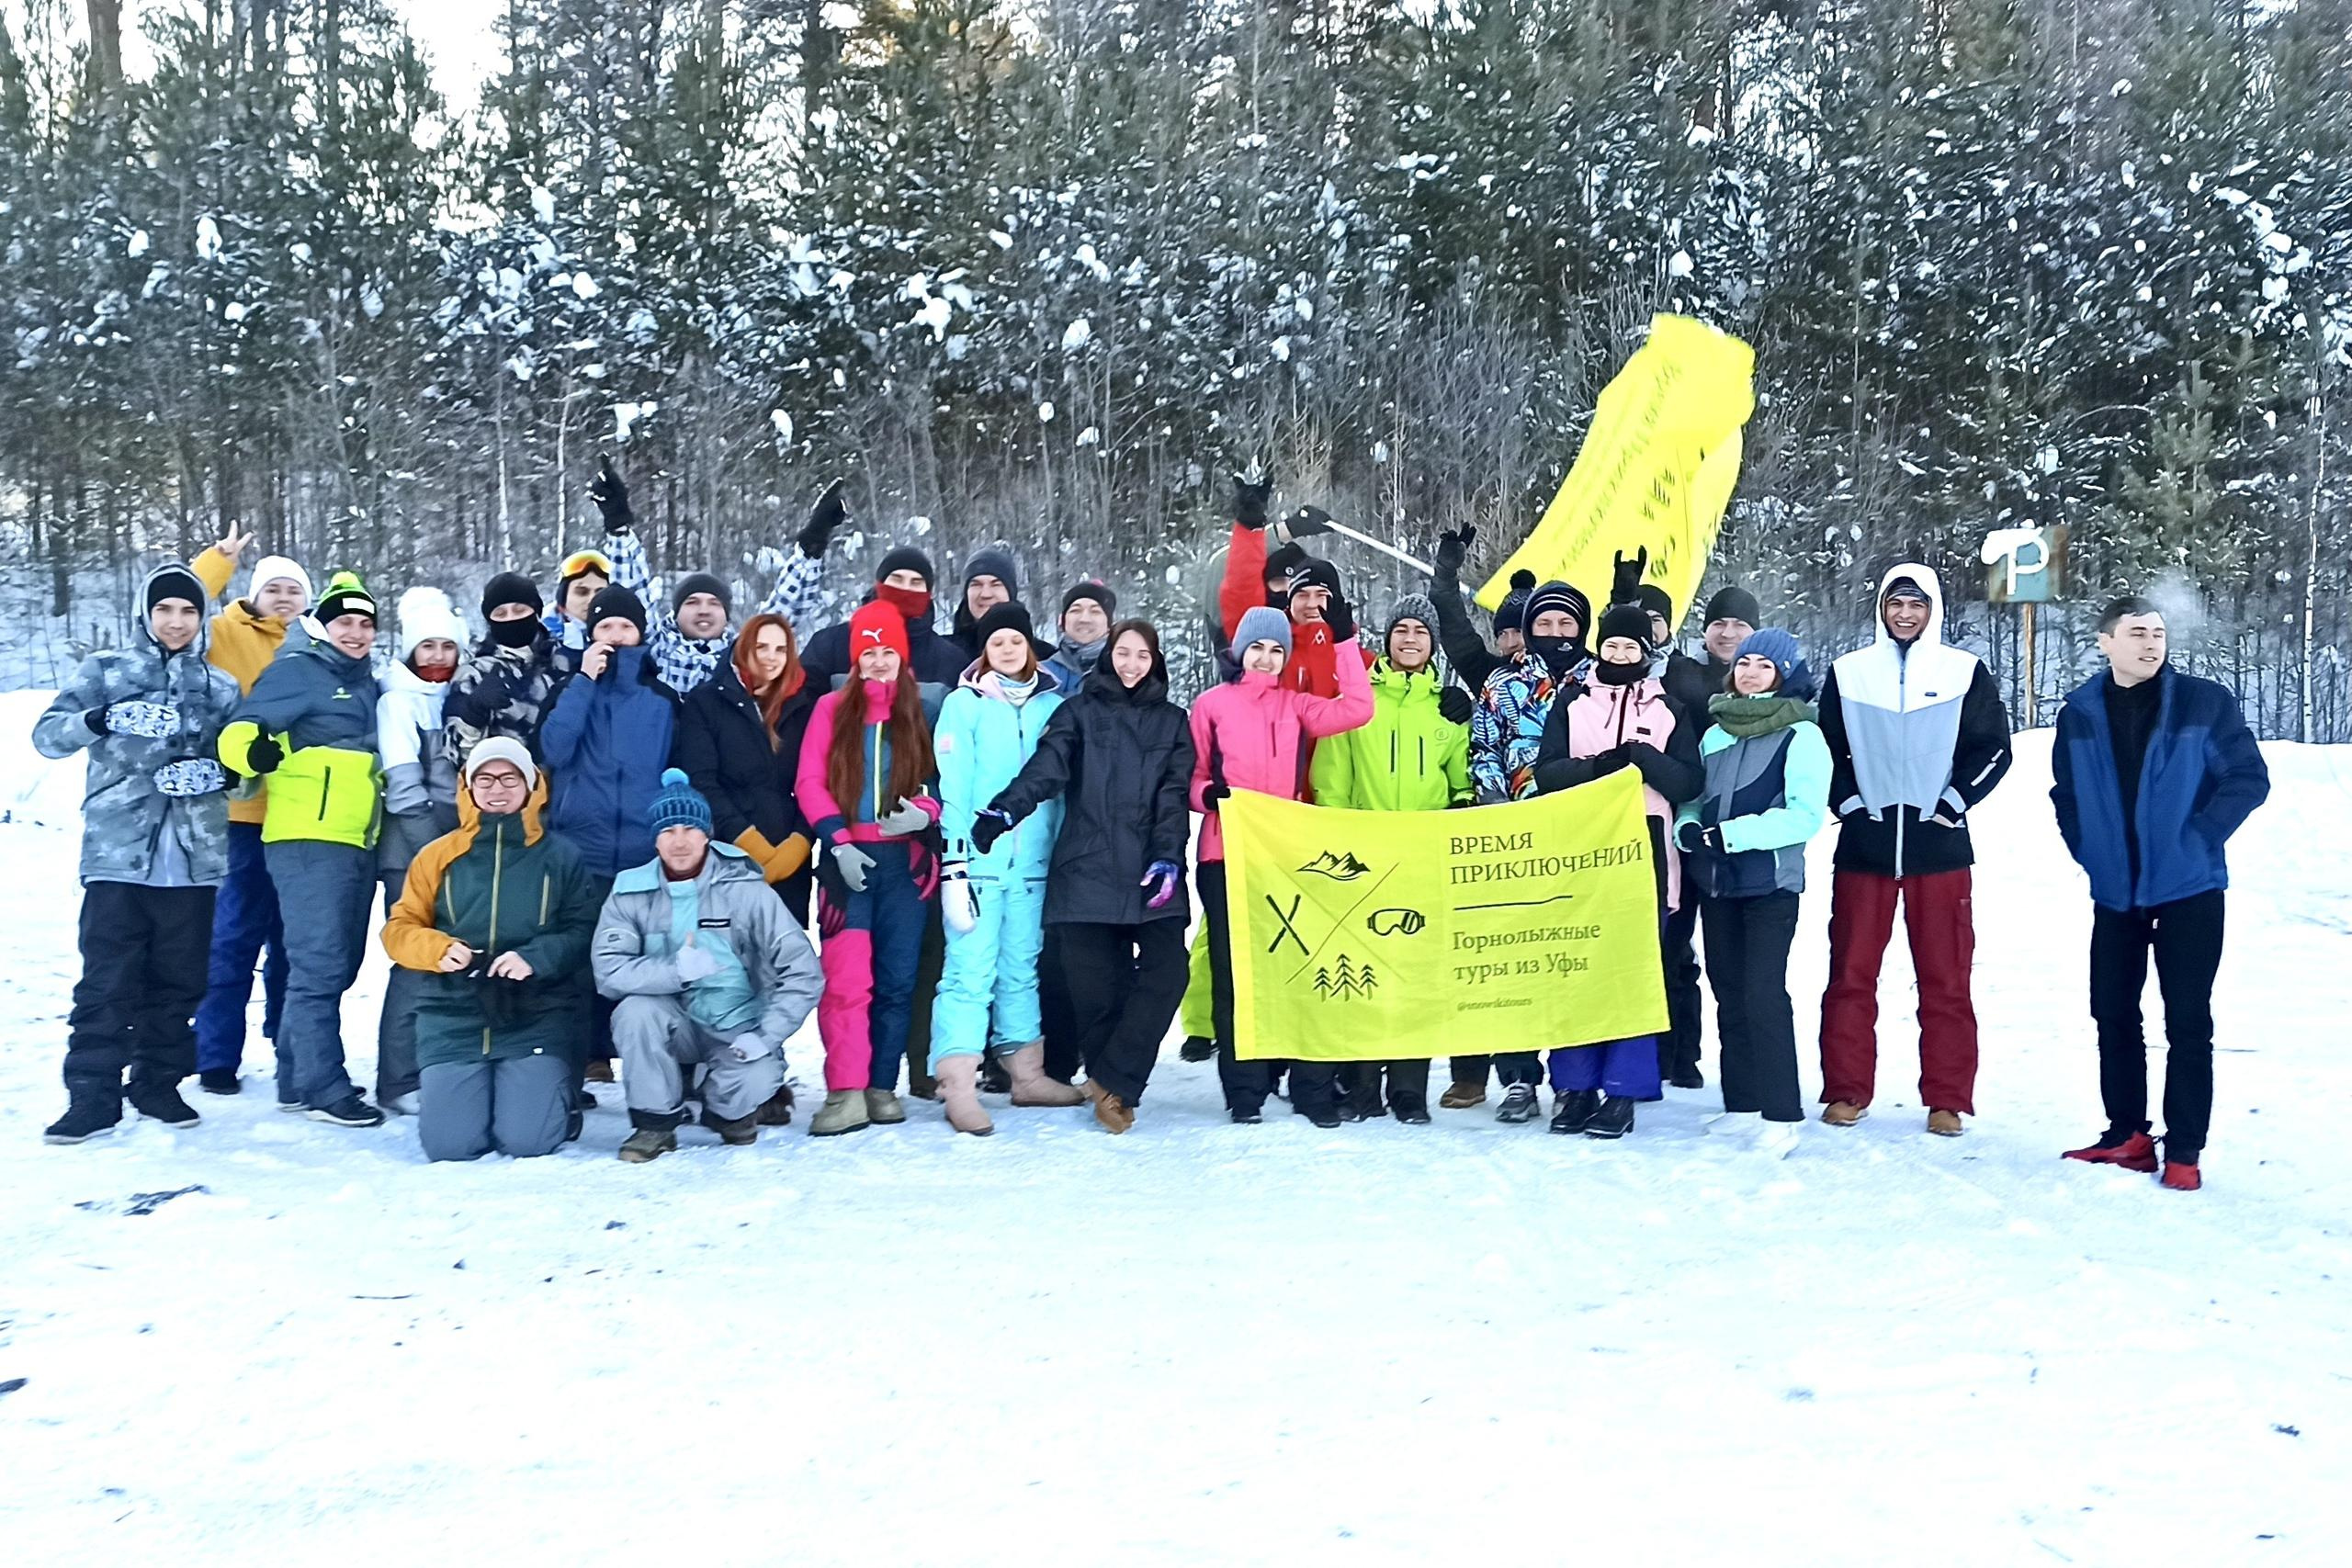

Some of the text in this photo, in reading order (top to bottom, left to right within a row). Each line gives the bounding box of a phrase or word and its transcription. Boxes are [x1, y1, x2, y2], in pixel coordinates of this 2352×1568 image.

[2007, 535, 2050, 595] P
[1449, 832, 1532, 855] ВРЕМЯ
[1449, 837, 1643, 885] ПРИКЛЮЧЕНИЙ
[1453, 924, 1600, 953] Горнолыжные
[1453, 951, 1589, 985] туры из Уфы
